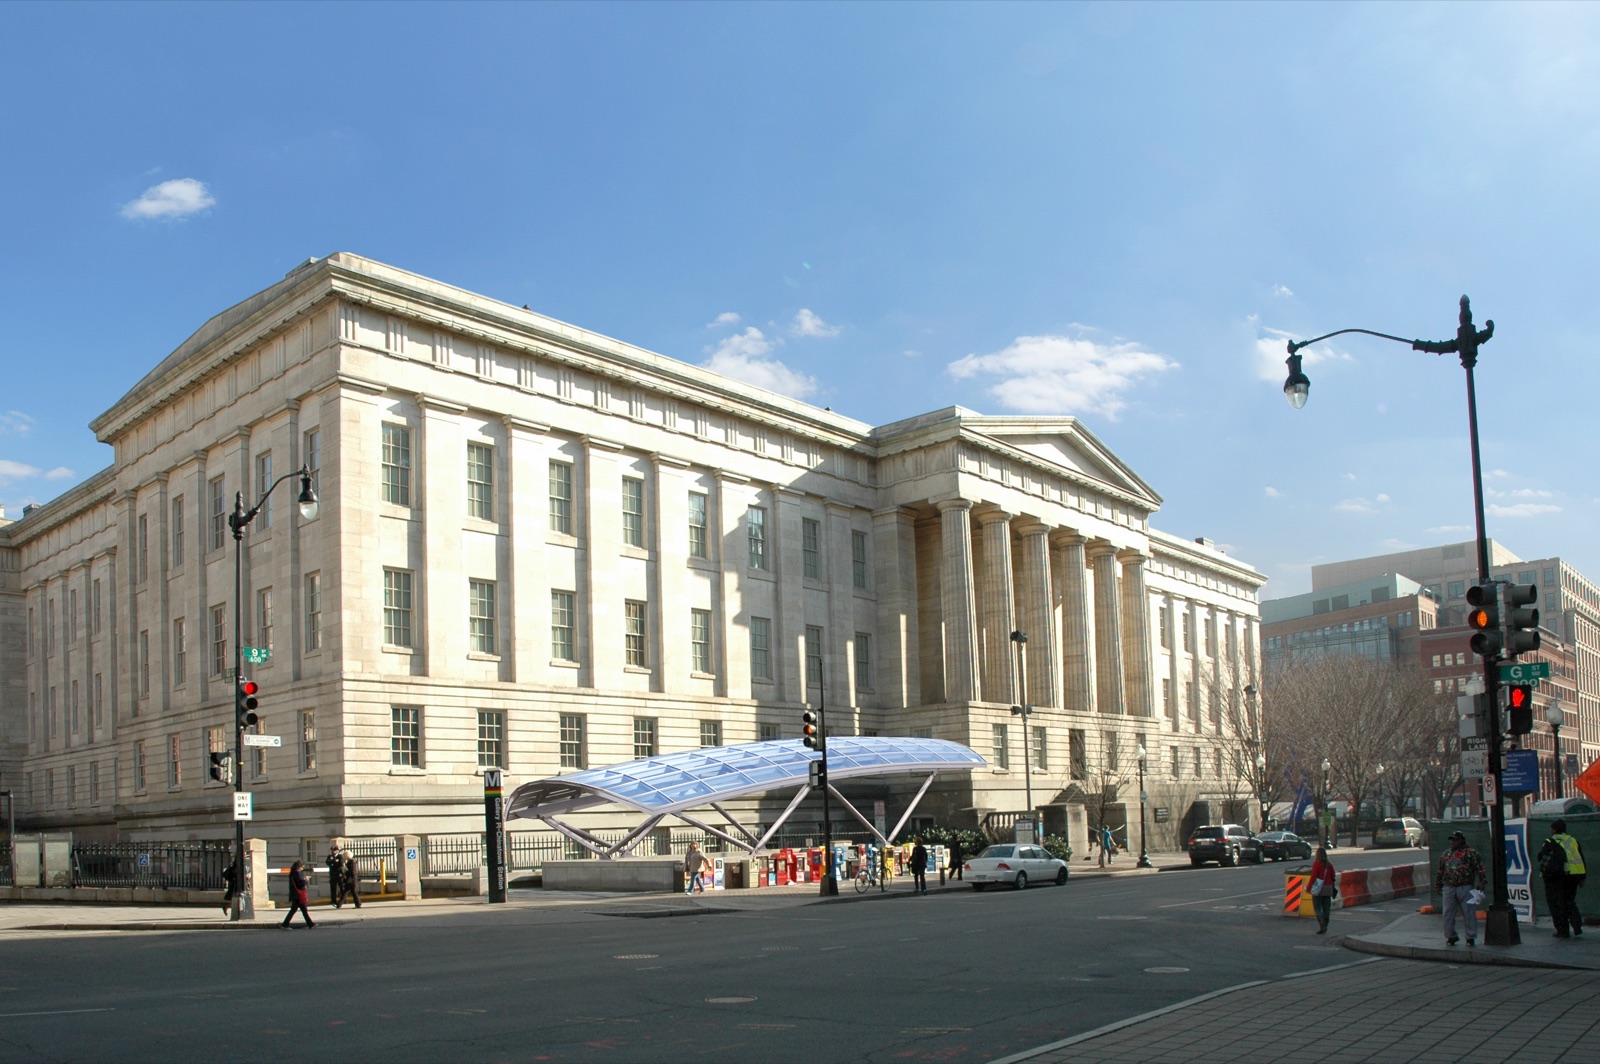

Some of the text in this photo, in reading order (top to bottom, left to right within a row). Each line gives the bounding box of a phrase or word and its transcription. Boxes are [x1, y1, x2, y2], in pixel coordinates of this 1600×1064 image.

[251, 648, 258, 657] 9
[1510, 665, 1522, 678] G
[485, 771, 500, 787] M
